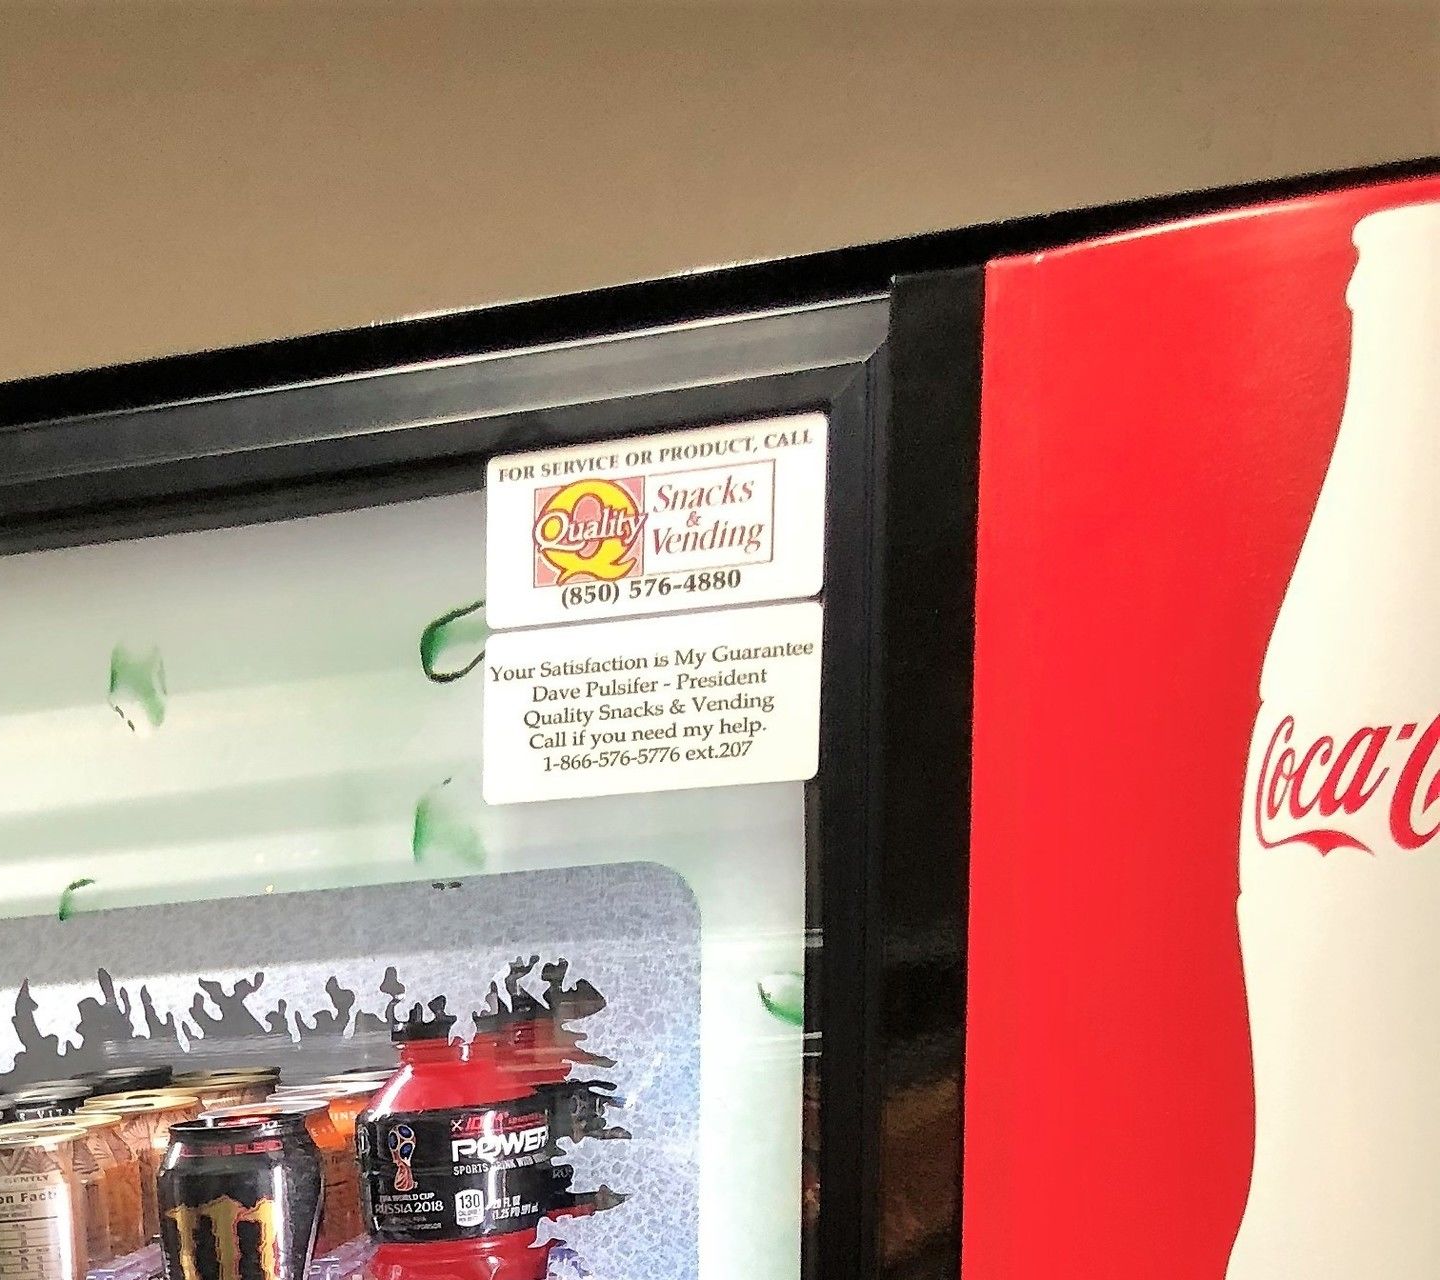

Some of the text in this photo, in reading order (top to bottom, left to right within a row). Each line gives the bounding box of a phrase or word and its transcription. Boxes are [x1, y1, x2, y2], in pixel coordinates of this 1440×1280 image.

[498, 430, 812, 483] FOR SERVICE OR PRODUCT, CALL
[653, 475, 754, 513] Snacks
[534, 508, 647, 553] Quality
[687, 511, 701, 527] &
[653, 519, 764, 556] Vending
[561, 569, 741, 609] (850) 576-4880
[491, 641, 813, 682] Your Satisfaction is My Guarantee
[533, 685, 580, 702] Dave
[586, 677, 658, 698] Pulsifer
[677, 669, 767, 690] President
[524, 693, 775, 729] Quality Snacks & Vending
[529, 717, 767, 750] Call if you need my help.
[544, 741, 752, 772] 1-866-576-5776 ext.207
[454, 1164, 489, 1175] SPORTS
[375, 1201, 443, 1214] RUSSIA 2018
[459, 1194, 480, 1208] 130
